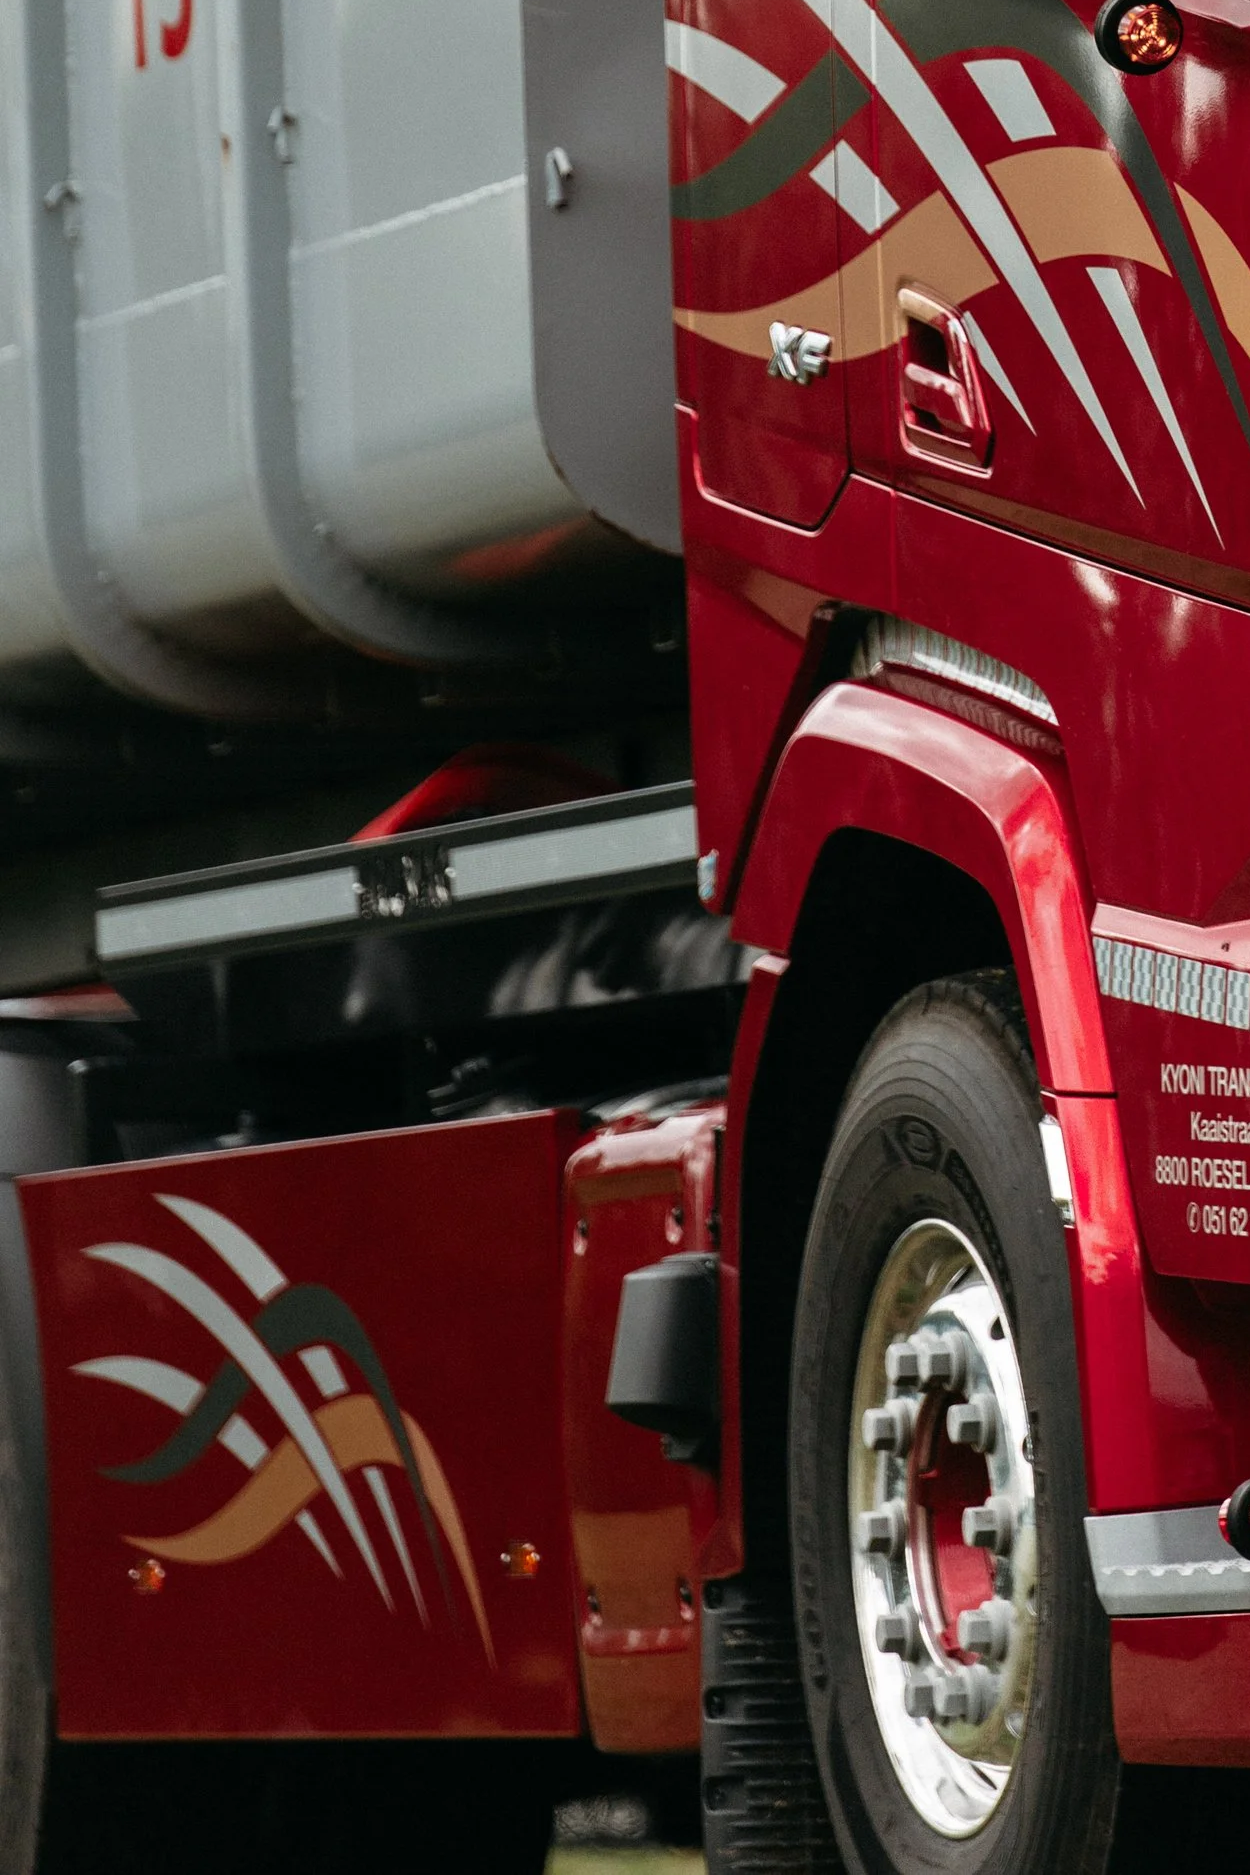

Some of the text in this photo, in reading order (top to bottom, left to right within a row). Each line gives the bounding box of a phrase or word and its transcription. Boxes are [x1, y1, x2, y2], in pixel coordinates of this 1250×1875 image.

[766, 320, 833, 385] XF
[1161, 1063, 1205, 1095] KYONI
[1155, 1155, 1189, 1186] 8800
[1202, 1204, 1228, 1235] 051
[1229, 1206, 1249, 1237] 62
